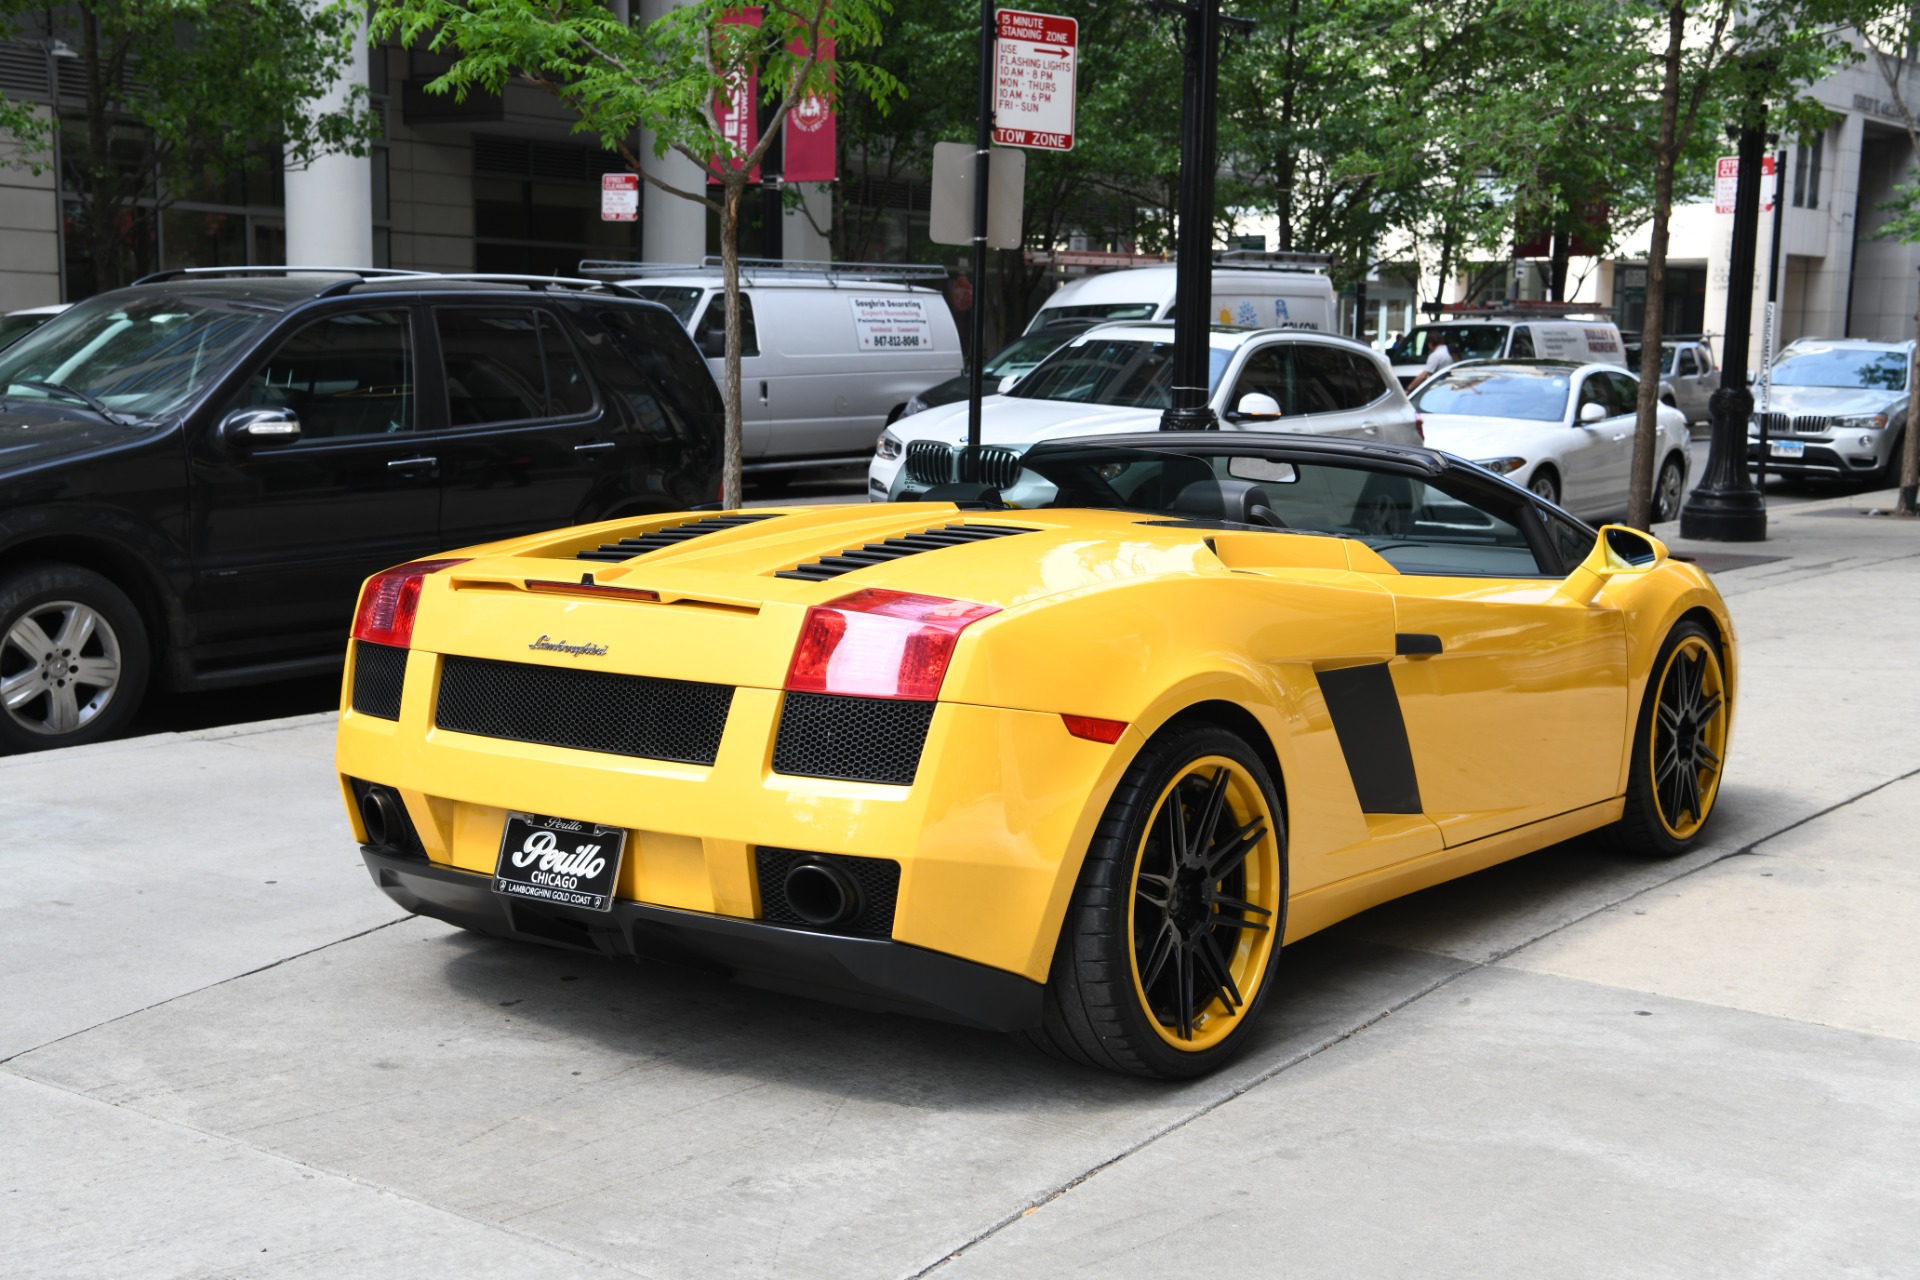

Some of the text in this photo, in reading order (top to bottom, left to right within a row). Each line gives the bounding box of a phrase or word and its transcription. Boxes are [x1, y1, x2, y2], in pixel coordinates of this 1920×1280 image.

[1002, 14, 1044, 29] 15 MINUTE
[1001, 26, 1068, 43] STANDING ZONE
[1001, 43, 1018, 55] USE
[1000, 55, 1071, 72] FLASHING LIGHTS
[1000, 66, 1009, 76] 10
[1011, 68, 1024, 77] AM
[1032, 70, 1038, 79] 8
[1041, 71, 1053, 81] PM
[999, 78, 1019, 88] MON
[1028, 80, 1057, 92] THURS
[999, 89, 1008, 98] 10
[1009, 90, 1022, 99] AM
[1031, 92, 1037, 101] 6
[1039, 93, 1051, 103] PM
[998, 100, 1013, 110] FRI
[1021, 101, 1039, 112] SUN
[999, 129, 1066, 148] TOW ZONE
[887, 300, 921, 310] Decorating
[1764, 304, 1773, 370] CONSIGNMENT
[528, 634, 609, 657] Lamborghini
[543, 817, 583, 831] Perillo
[511, 831, 606, 879] Perillo
[531, 870, 578, 890] CHICAGO
[508, 883, 592, 905] LAMBORGHINI GOLD COAST
